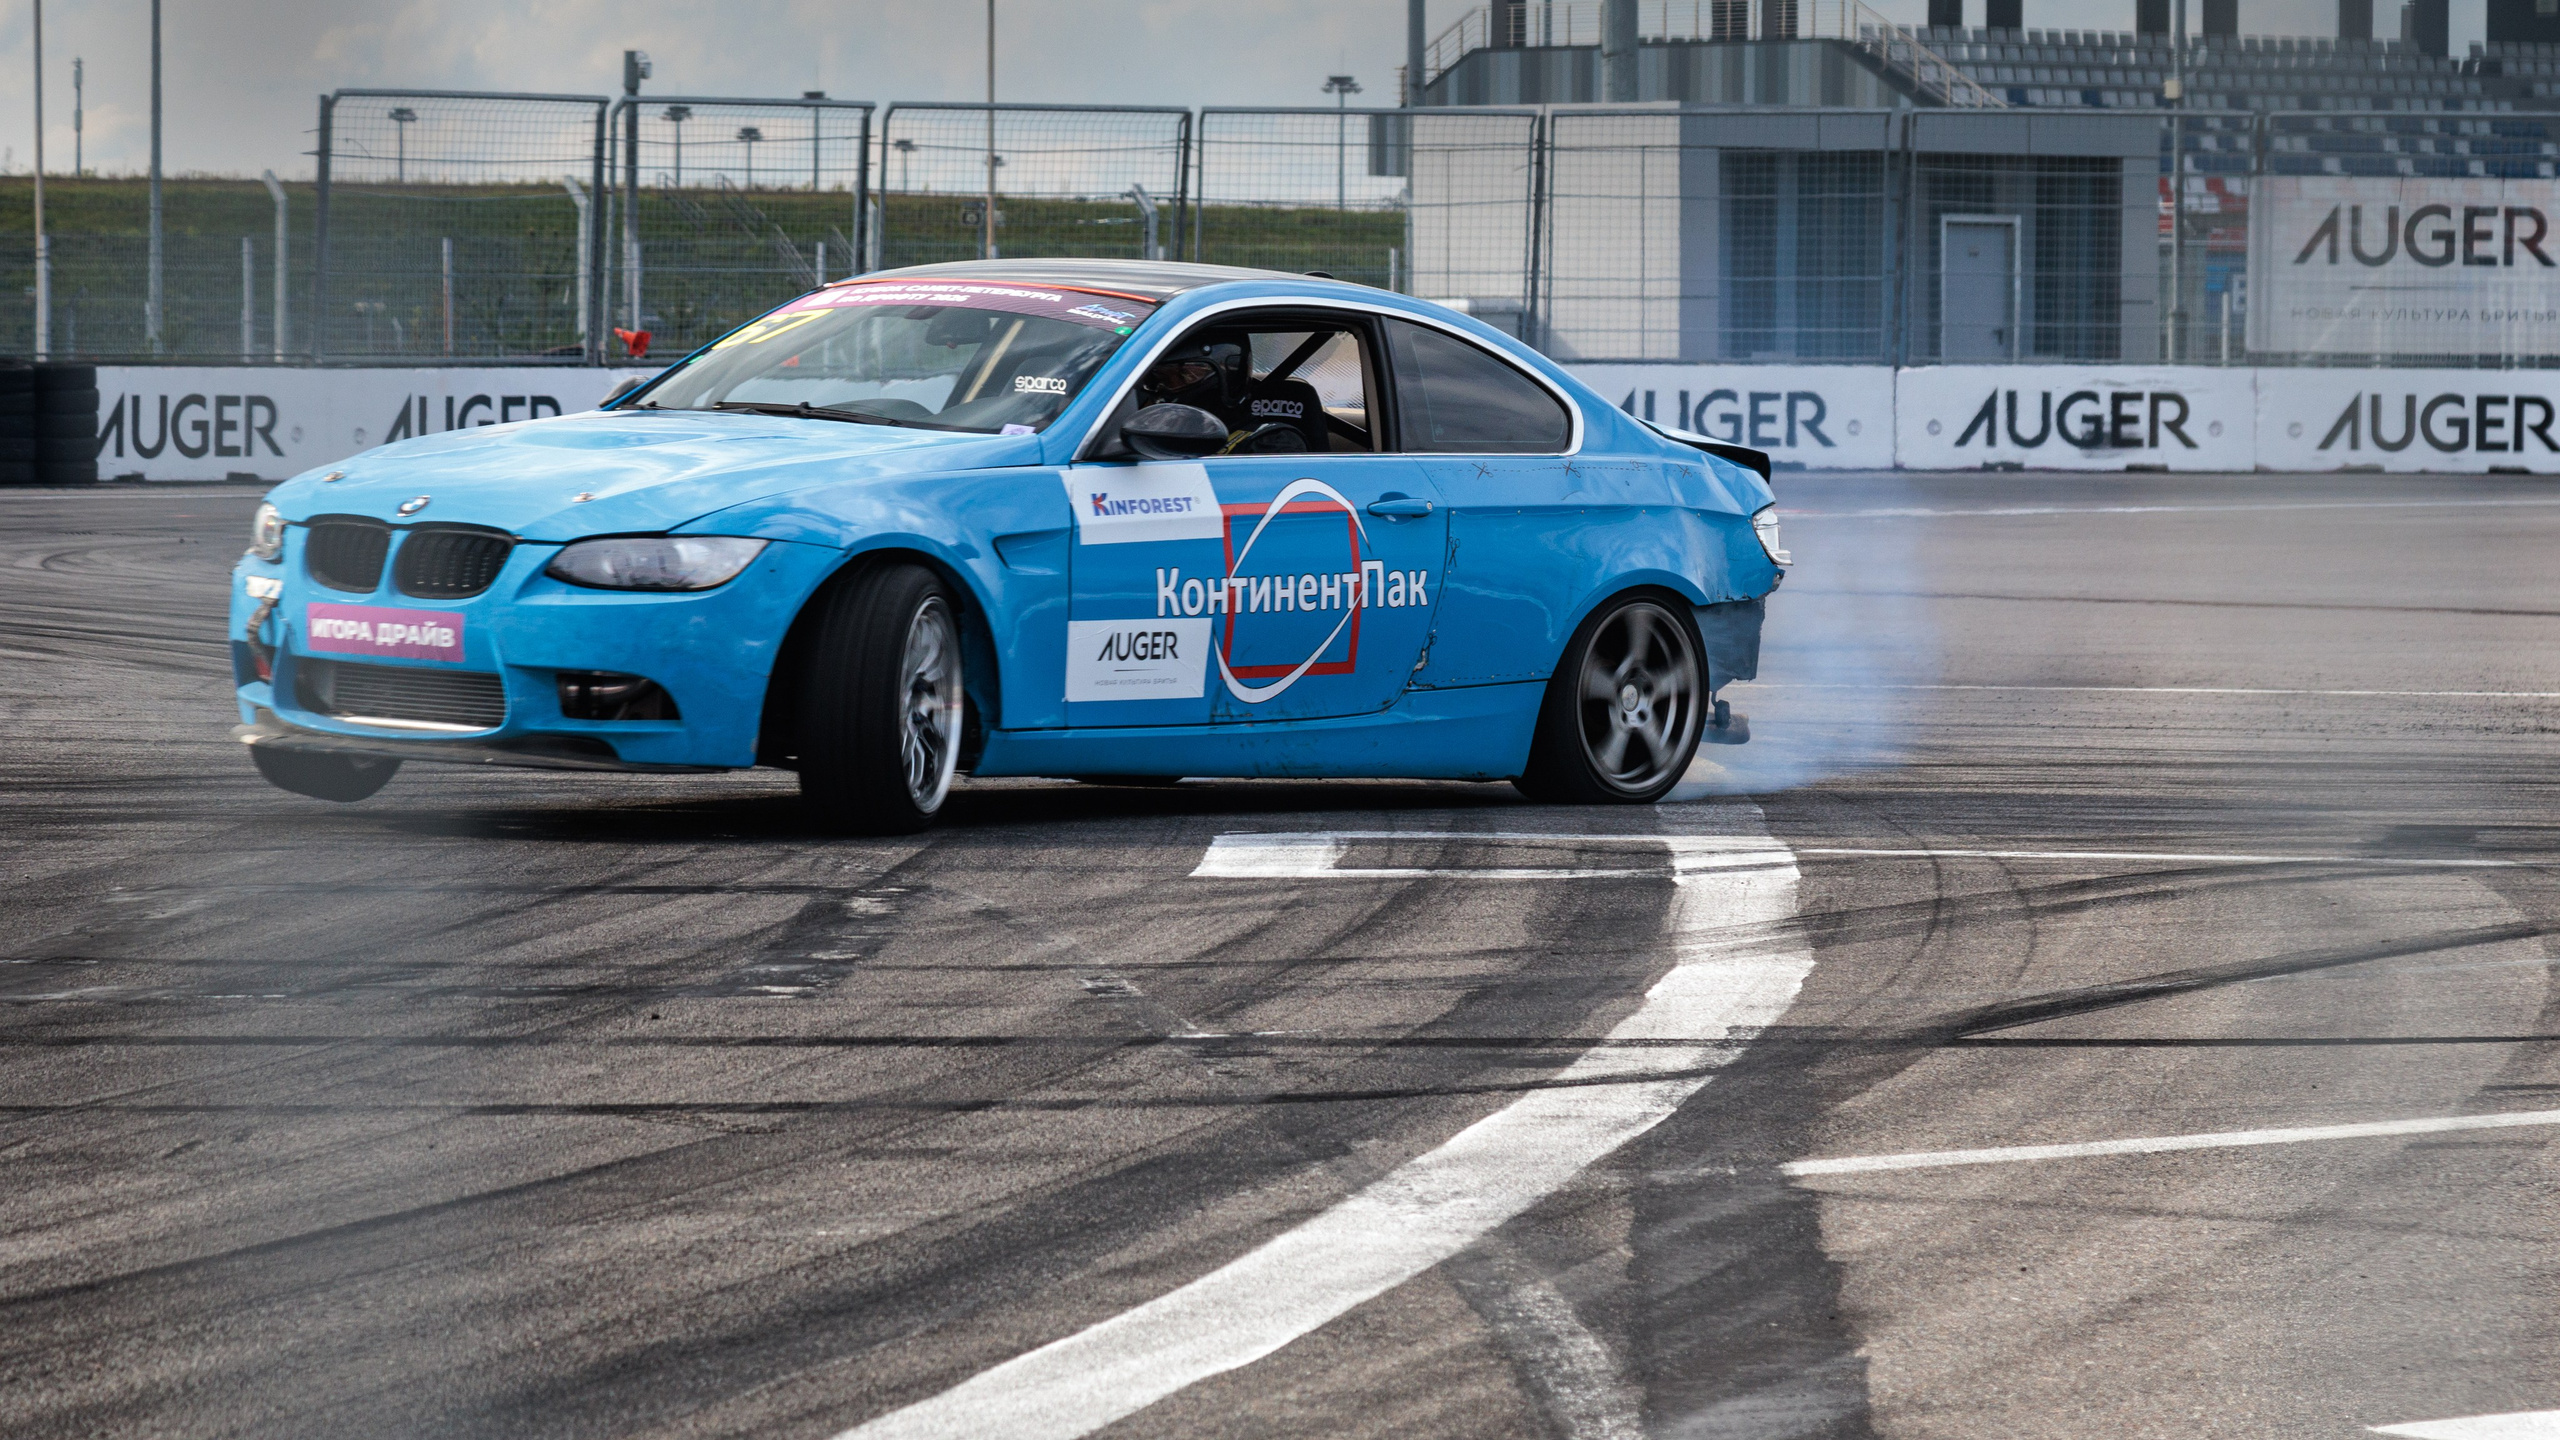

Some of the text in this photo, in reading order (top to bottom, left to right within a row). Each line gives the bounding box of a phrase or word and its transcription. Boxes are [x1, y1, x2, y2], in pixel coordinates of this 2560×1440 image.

[2293, 202, 2557, 268] AUGER
[711, 308, 835, 350] 67
[1014, 374, 1067, 393] sparco
[1250, 399, 1304, 417] sparco
[96, 392, 285, 459] AUGER
[1954, 387, 2199, 451] AUGER
[2317, 389, 2560, 453] AUGER
[1155, 559, 1429, 617] КонтинентПак
[310, 618, 456, 648] ИГОРА ДРАЙВ
[1097, 631, 1180, 662] AUGER
